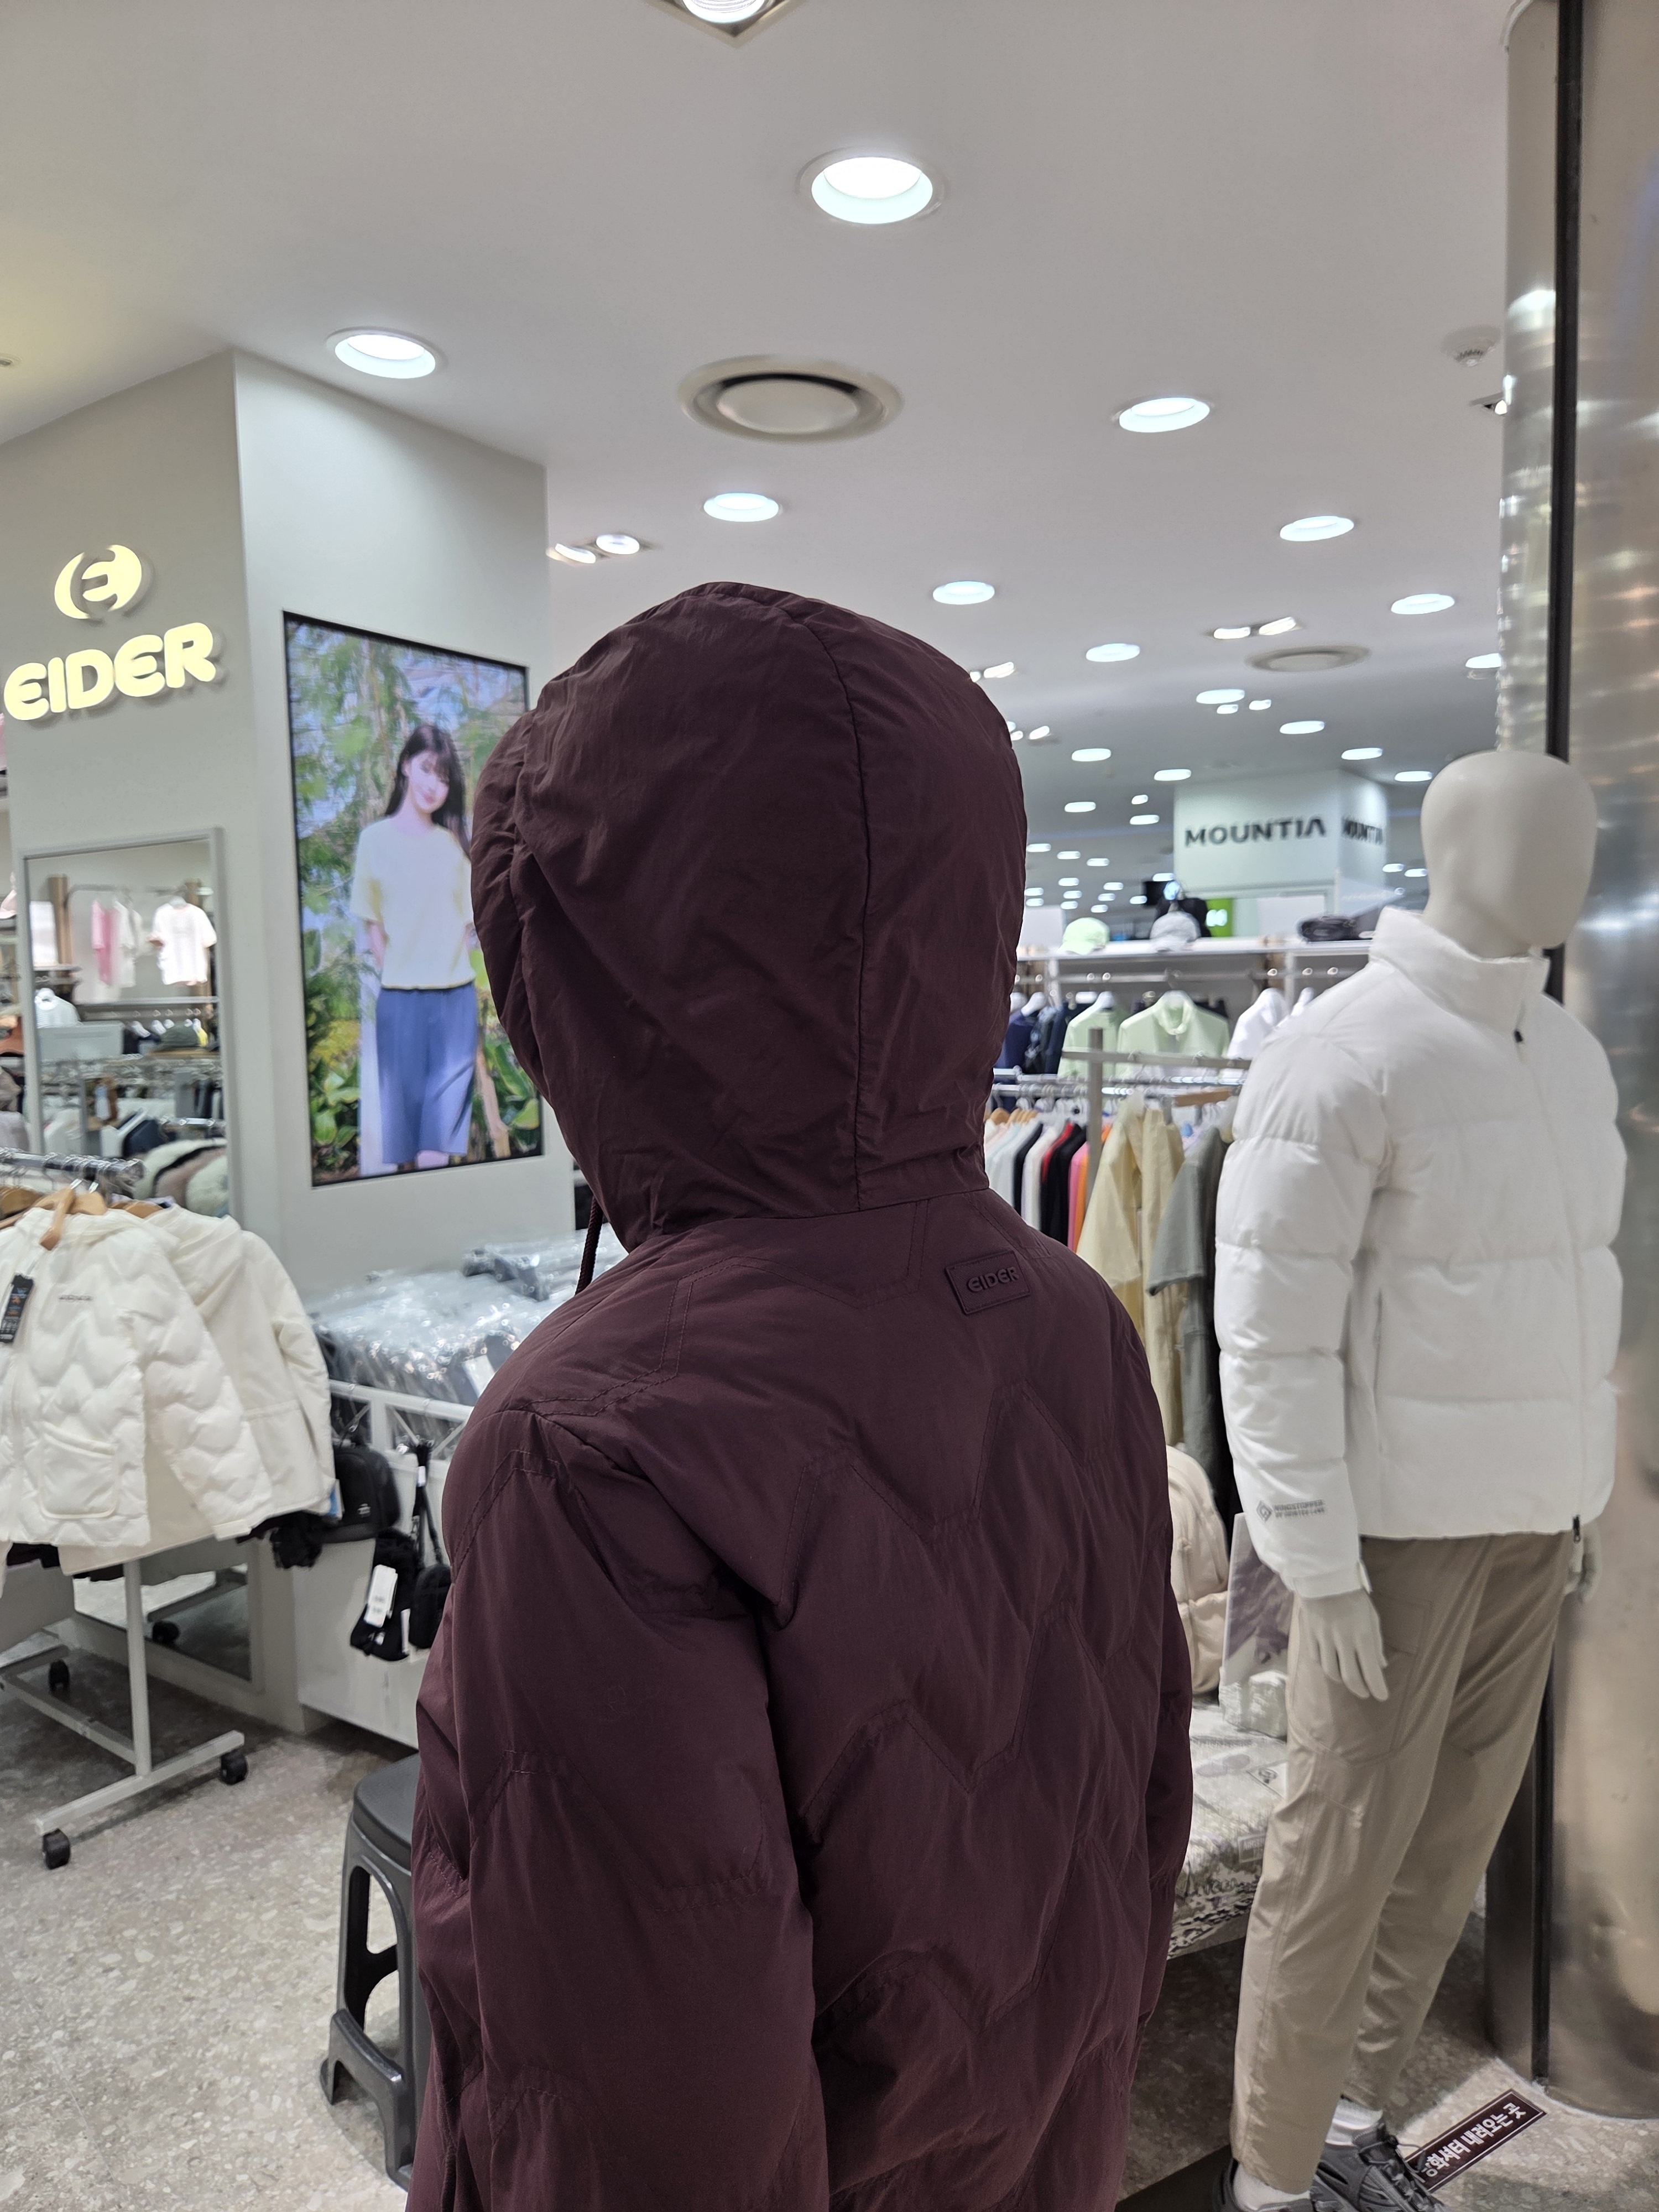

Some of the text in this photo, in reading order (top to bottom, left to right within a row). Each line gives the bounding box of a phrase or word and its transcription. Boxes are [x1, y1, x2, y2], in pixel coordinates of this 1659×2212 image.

[4, 622, 216, 720] EIDER
[1185, 817, 1327, 847] MOUNTIA
[967, 1267, 1019, 1292] EIDER
[1460, 2114, 1513, 2145] 내려오는
[1503, 2103, 1526, 2119] 곳
